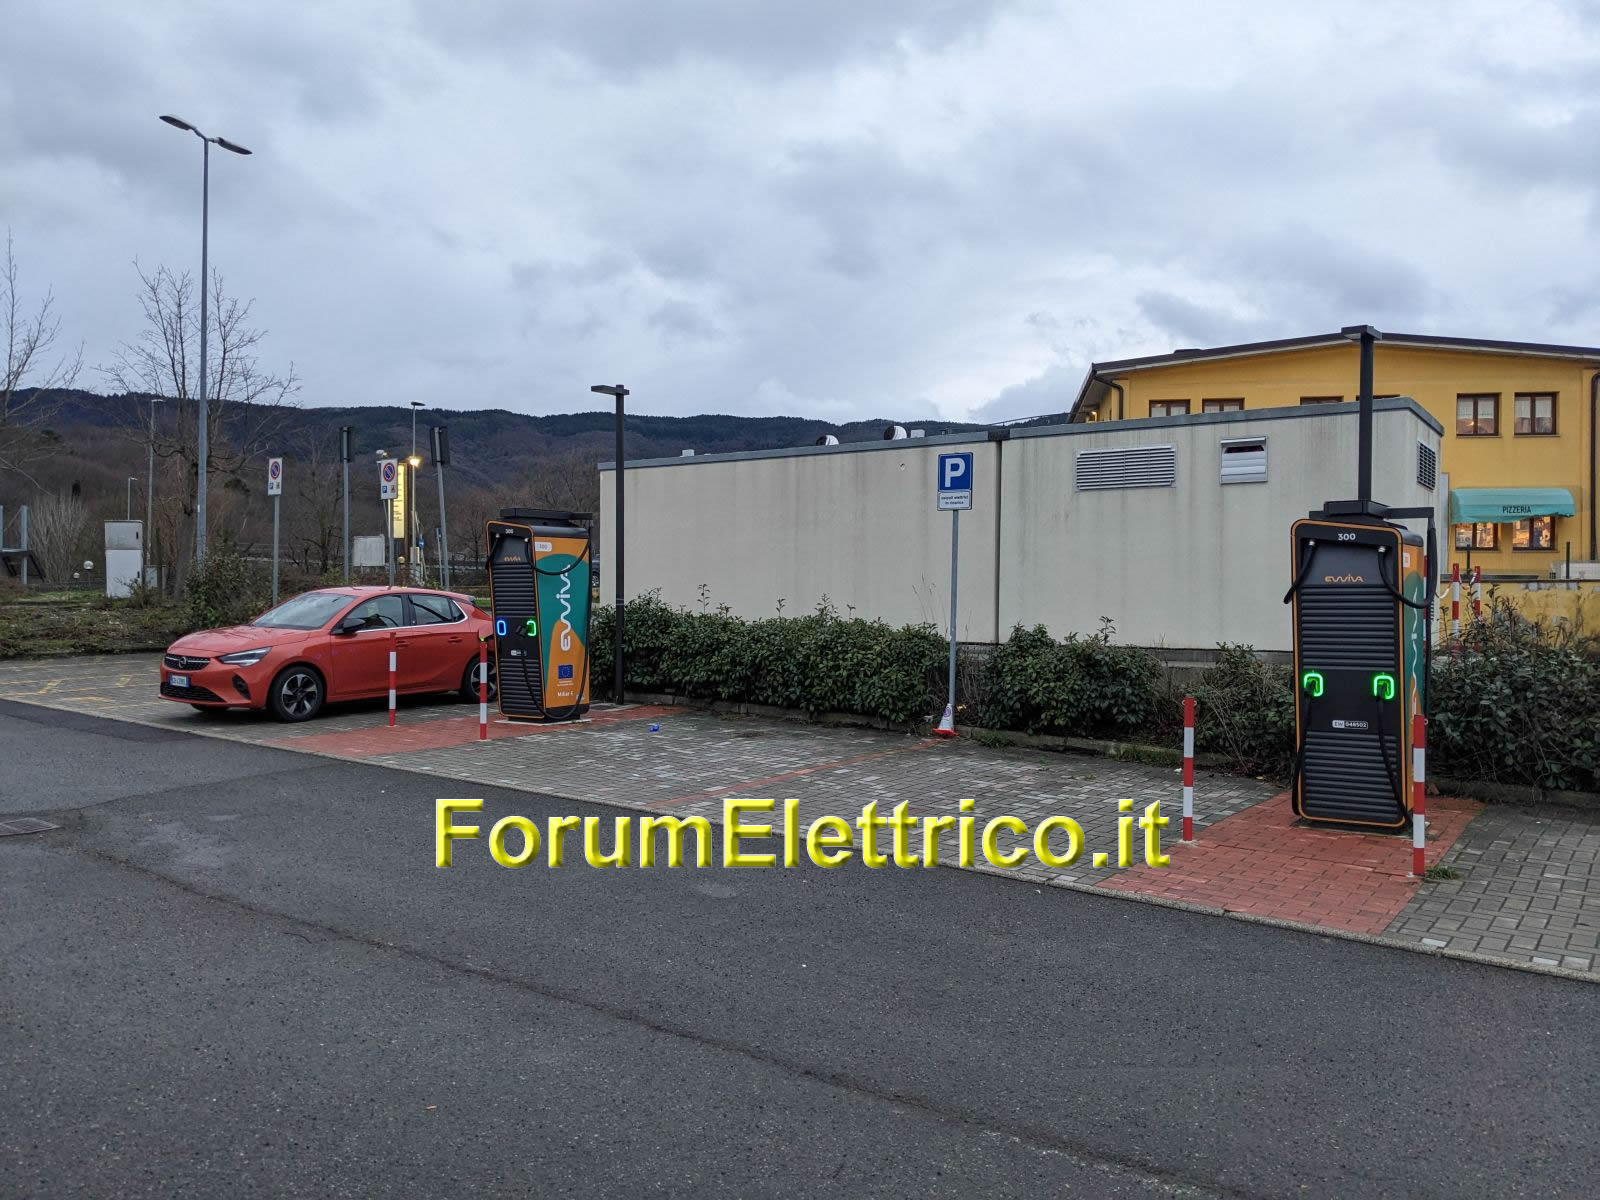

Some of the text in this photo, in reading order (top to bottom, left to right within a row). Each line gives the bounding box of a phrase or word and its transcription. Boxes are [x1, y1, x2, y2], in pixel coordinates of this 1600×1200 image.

[945, 457, 966, 488] P
[1502, 505, 1532, 514] PIZZERIA
[1337, 533, 1357, 541] 300
